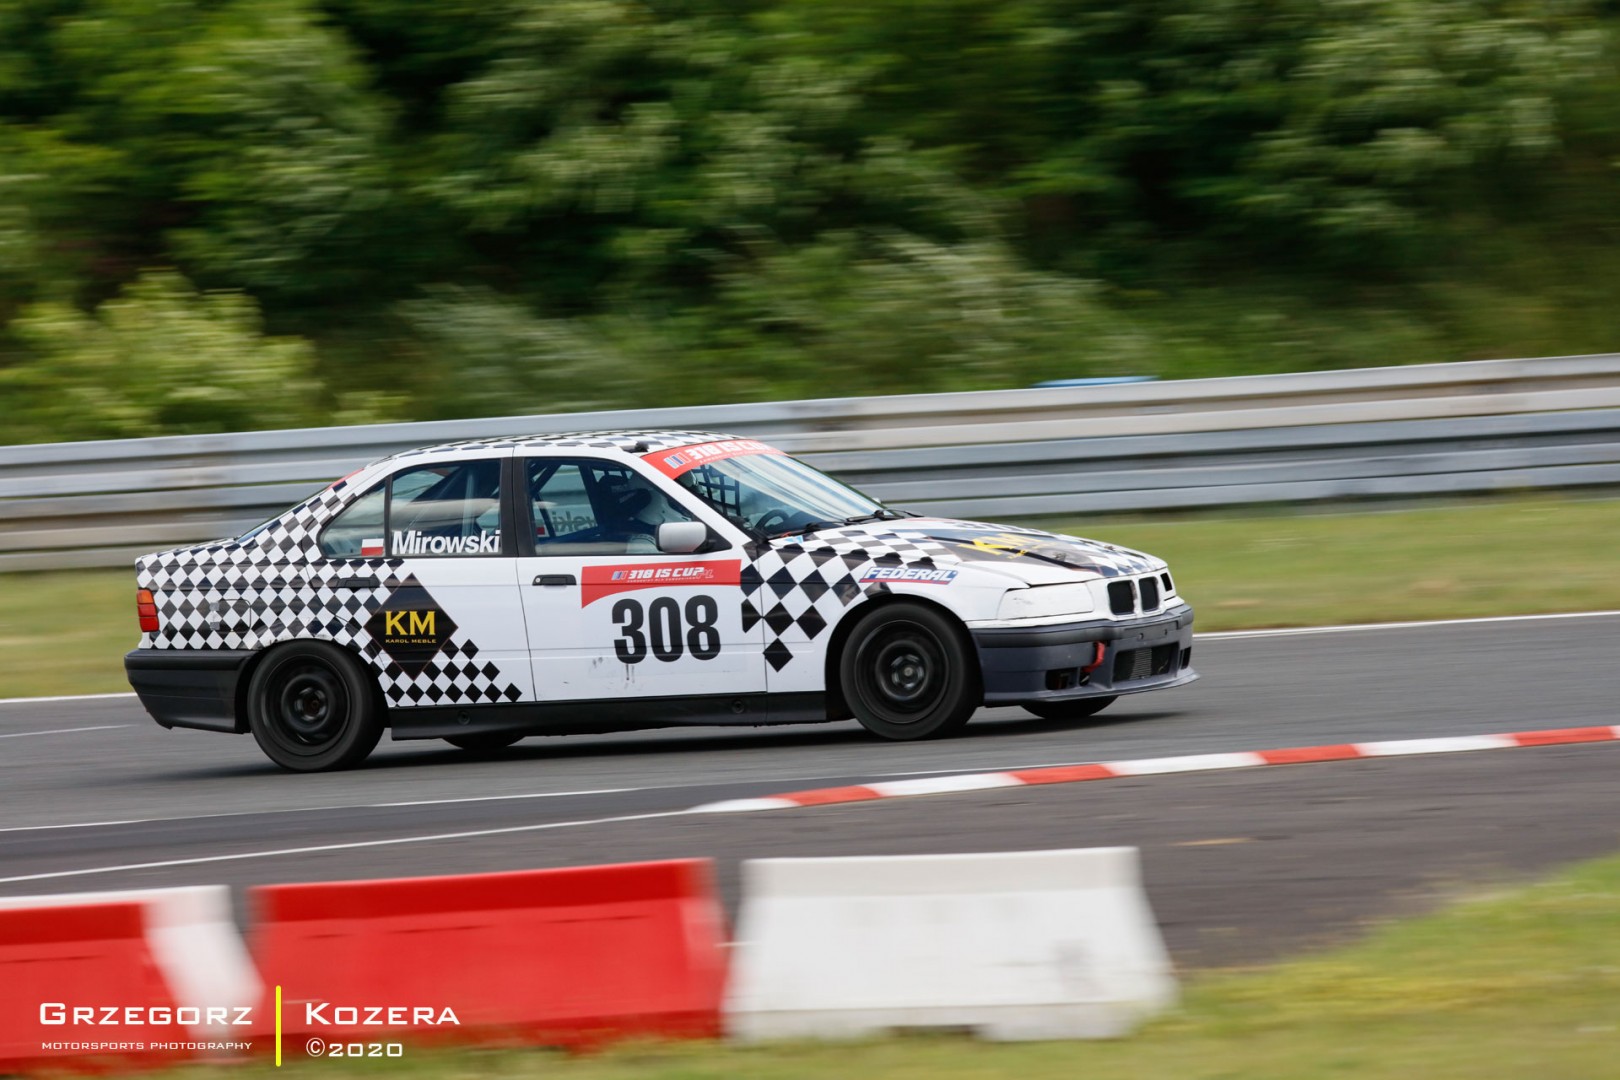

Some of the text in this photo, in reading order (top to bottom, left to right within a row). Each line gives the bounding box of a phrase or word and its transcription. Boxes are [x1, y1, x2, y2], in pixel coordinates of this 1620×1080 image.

[391, 530, 501, 555] Mirowski
[628, 568, 654, 580] 318
[655, 567, 672, 579] IS
[672, 566, 705, 578] CUP
[864, 566, 956, 581] FEDERAL
[385, 610, 436, 636] KM
[612, 593, 721, 664] 308
